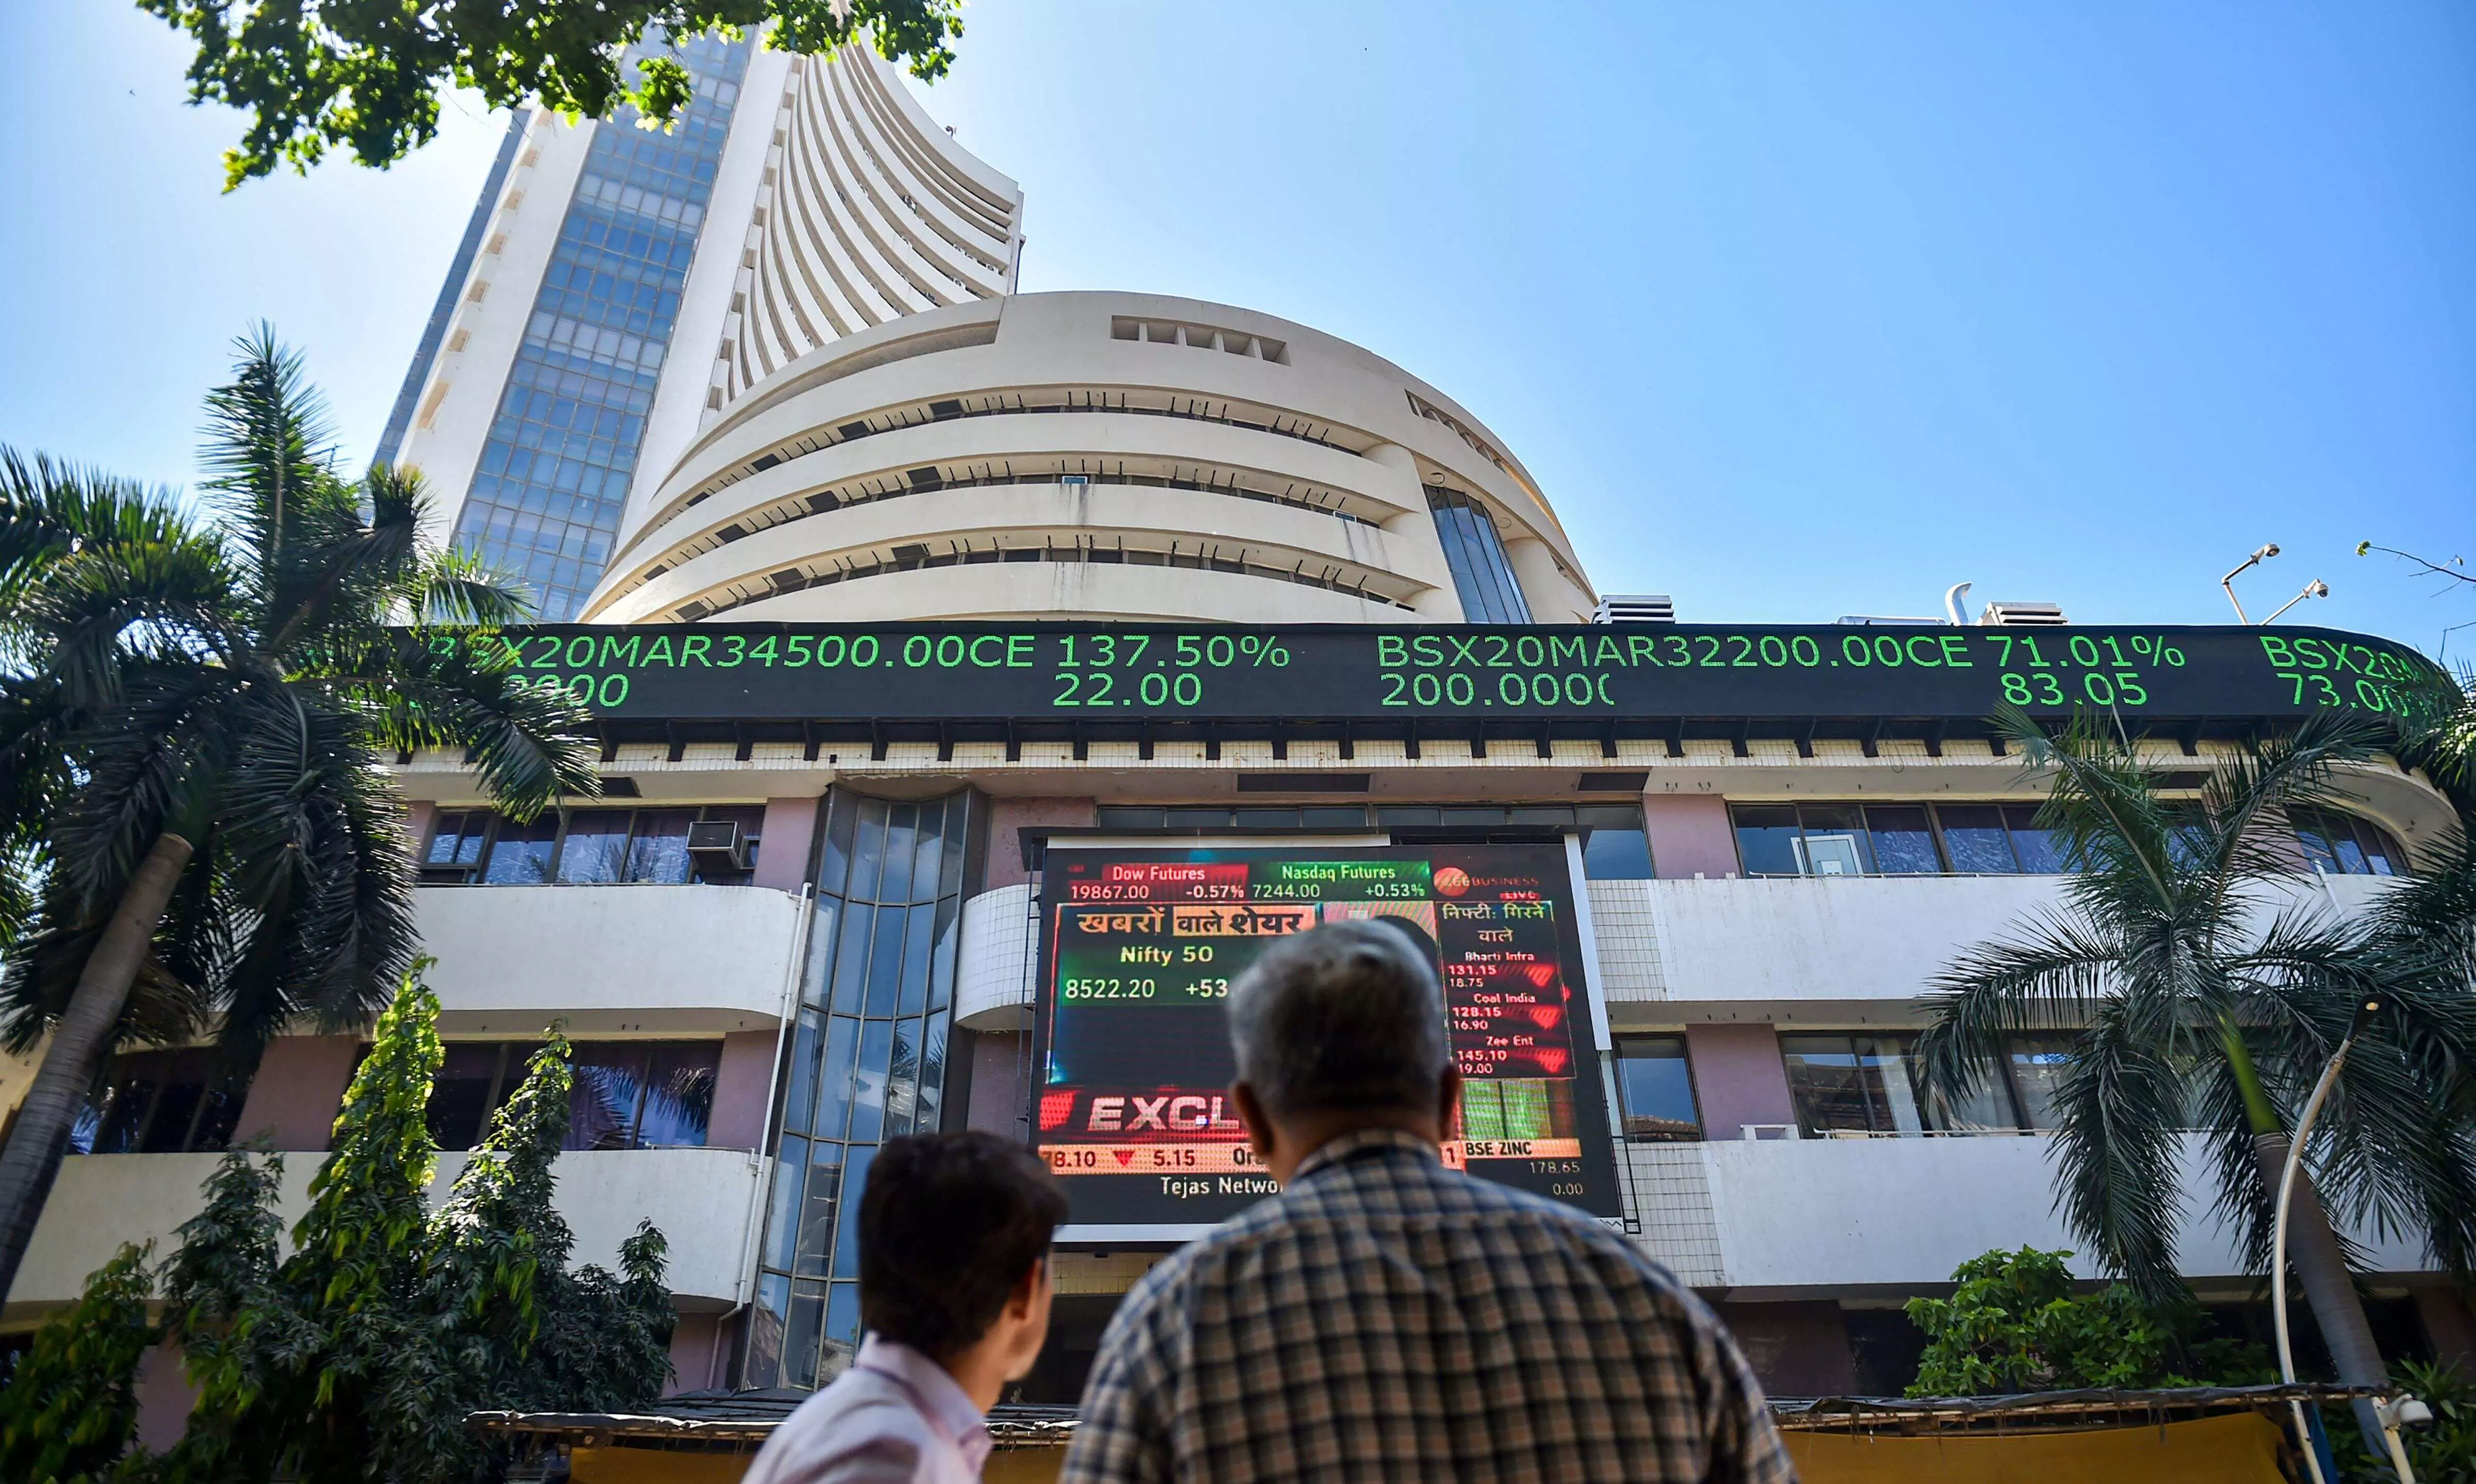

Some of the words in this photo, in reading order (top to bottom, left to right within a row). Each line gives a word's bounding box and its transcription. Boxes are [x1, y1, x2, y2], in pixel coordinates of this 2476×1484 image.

[1057, 635, 1290, 667] 137.50%
[1377, 635, 1974, 668] BSX20MAR32200.00CE
[1985, 635, 2186, 667] 71.01%
[1053, 673, 1202, 706] 22.00
[2000, 672, 2147, 705] 83.05
[1113, 866, 1146, 881] Dow
[1150, 865, 1205, 880] Futures
[1282, 865, 1335, 880] Nasdaq
[1342, 865, 1396, 879] Futures
[1071, 885, 1149, 899] 19867.00
[1186, 885, 1245, 899] -0.57%
[1252, 884, 1320, 898] 7244.00
[1365, 884, 1425, 897] +0.53%
[1077, 906, 1165, 935] खबरों
[1176, 909, 1224, 934] वाले
[1228, 906, 1304, 934] शेयर
[1477, 926, 1513, 943] वाले
[1120, 947, 1173, 967] Nifty
[1182, 946, 1214, 963] 50
[1465, 952, 1501, 962] Bharti
[1448, 965, 1497, 975] 131.15
[1065, 979, 1155, 999] 8522.20
[1186, 979, 1228, 998] +53
[1449, 978, 1484, 988] 18.75
[1474, 993, 1501, 1004] Coal
[1505, 993, 1536, 1003] India
[1453, 1007, 1502, 1018] 128.15
[1453, 1020, 1489, 1030] 16.90
[1486, 1036, 1509, 1046] Zee
[1513, 1035, 1534, 1046] Ent
[1457, 1050, 1507, 1061] 145.10
[1459, 1063, 1493, 1074] 19.00
[1088, 1097, 1240, 1131] EXCL
[1465, 1141, 1494, 1155] BSE
[1499, 1141, 1533, 1154] ZINC
[1153, 1149, 1195, 1166] 5.15
[1530, 1162, 1580, 1173] 178.65
[1161, 1177, 1210, 1199] Tejas
[1553, 1183, 1583, 1195] 0.00
